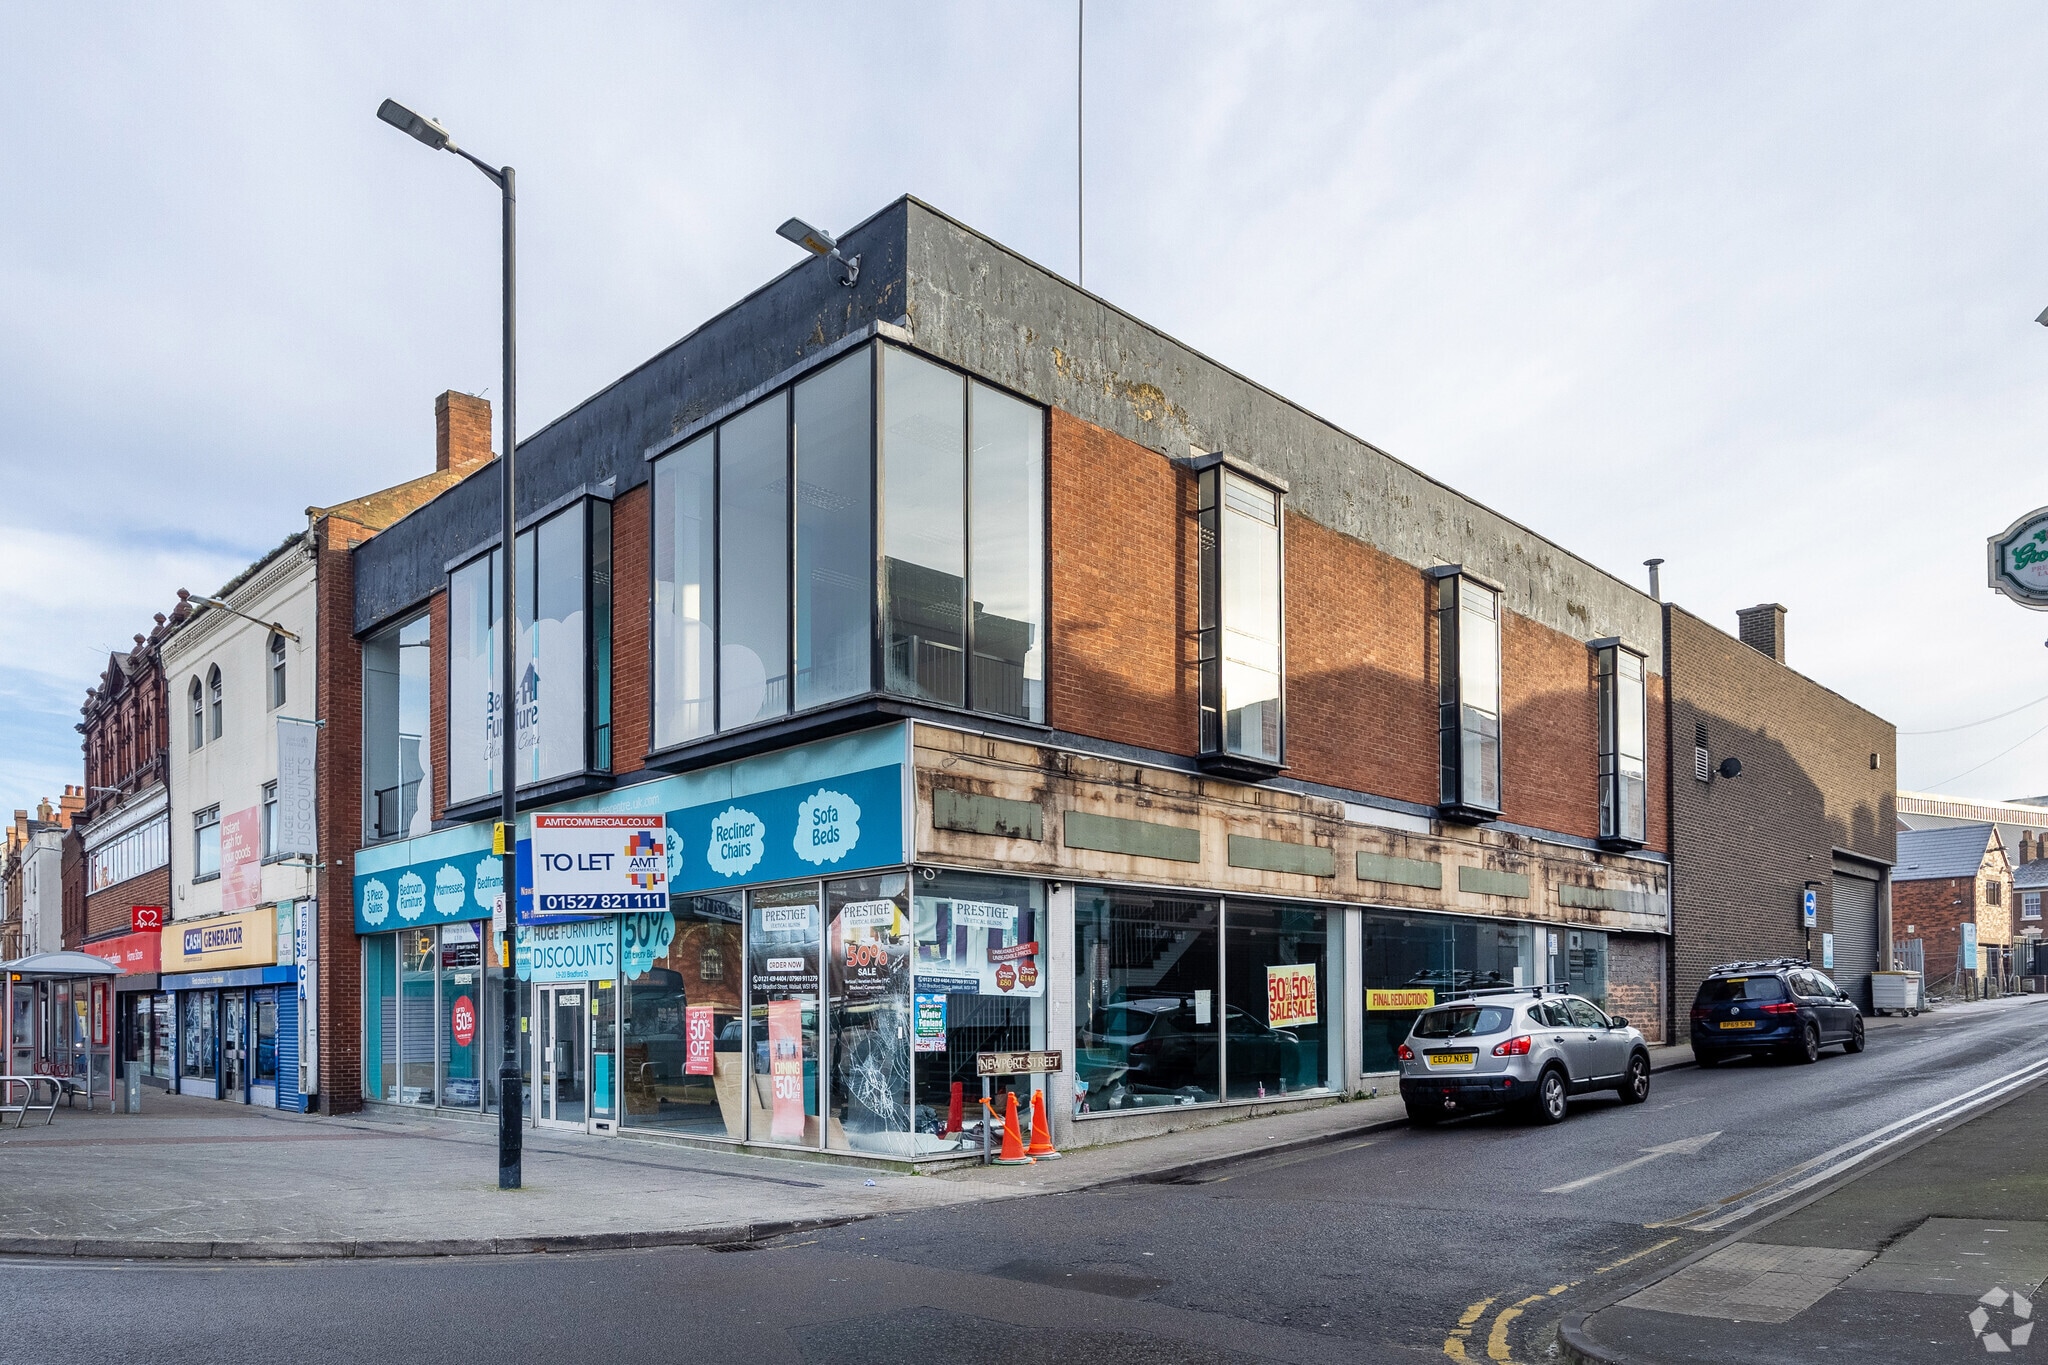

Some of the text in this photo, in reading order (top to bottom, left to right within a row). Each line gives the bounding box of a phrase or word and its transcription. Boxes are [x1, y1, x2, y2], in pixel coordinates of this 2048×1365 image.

[487, 705, 538, 740] Future
[297, 757, 311, 846] DISCOUNTS
[544, 817, 656, 827] AMTCOMMERCIAL.CO.UK
[813, 805, 838, 826] Sofa
[223, 820, 240, 836] Instant
[716, 822, 755, 842] Recliner
[813, 826, 840, 846] Beds
[223, 836, 234, 850] cash
[721, 842, 751, 860] Chairs
[235, 844, 251, 864] goods
[540, 853, 615, 872] TO LET
[629, 857, 658, 868] AMT
[367, 889, 384, 900] 3 Piece
[400, 883, 422, 896] Bedroom
[436, 882, 463, 896] Mattresses
[368, 902, 383, 914] Suites
[400, 896, 422, 909] Furniture
[546, 893, 660, 909] 01527 821 111
[765, 909, 806, 922] PRESTIGE
[844, 902, 890, 918] PRESTIGE
[956, 903, 1009, 919] PRESTIGE
[533, 921, 613, 942] HUGE FURNITURE
[624, 912, 669, 948] 50%
[185, 926, 243, 951] CASH GENERATOR
[533, 943, 614, 969] DISCOUNTS
[846, 943, 888, 967] 50%
[769, 961, 787, 969] ORDER
[857, 967, 876, 976] SALE
[567, 970, 583, 978] Bradford
[1269, 977, 1291, 1003] 50%
[1292, 975, 1315, 1000] 50%
[1372, 993, 1428, 1006] FINAL REDUCTIONS
[919, 1009, 942, 1019] Winter
[1270, 1001, 1292, 1022] SALE
[1292, 999, 1316, 1018] SALE
[456, 1012, 473, 1031] 50%
[689, 1019, 710, 1040] 50%
[918, 1018, 943, 1028] Funland
[690, 1041, 710, 1056] OFF
[980, 1056, 1058, 1070] NEWPORT STREET
[1433, 1054, 1470, 1063] CE07 NXB
[775, 1061, 800, 1074] DINING
[776, 1076, 800, 1099] 50%
